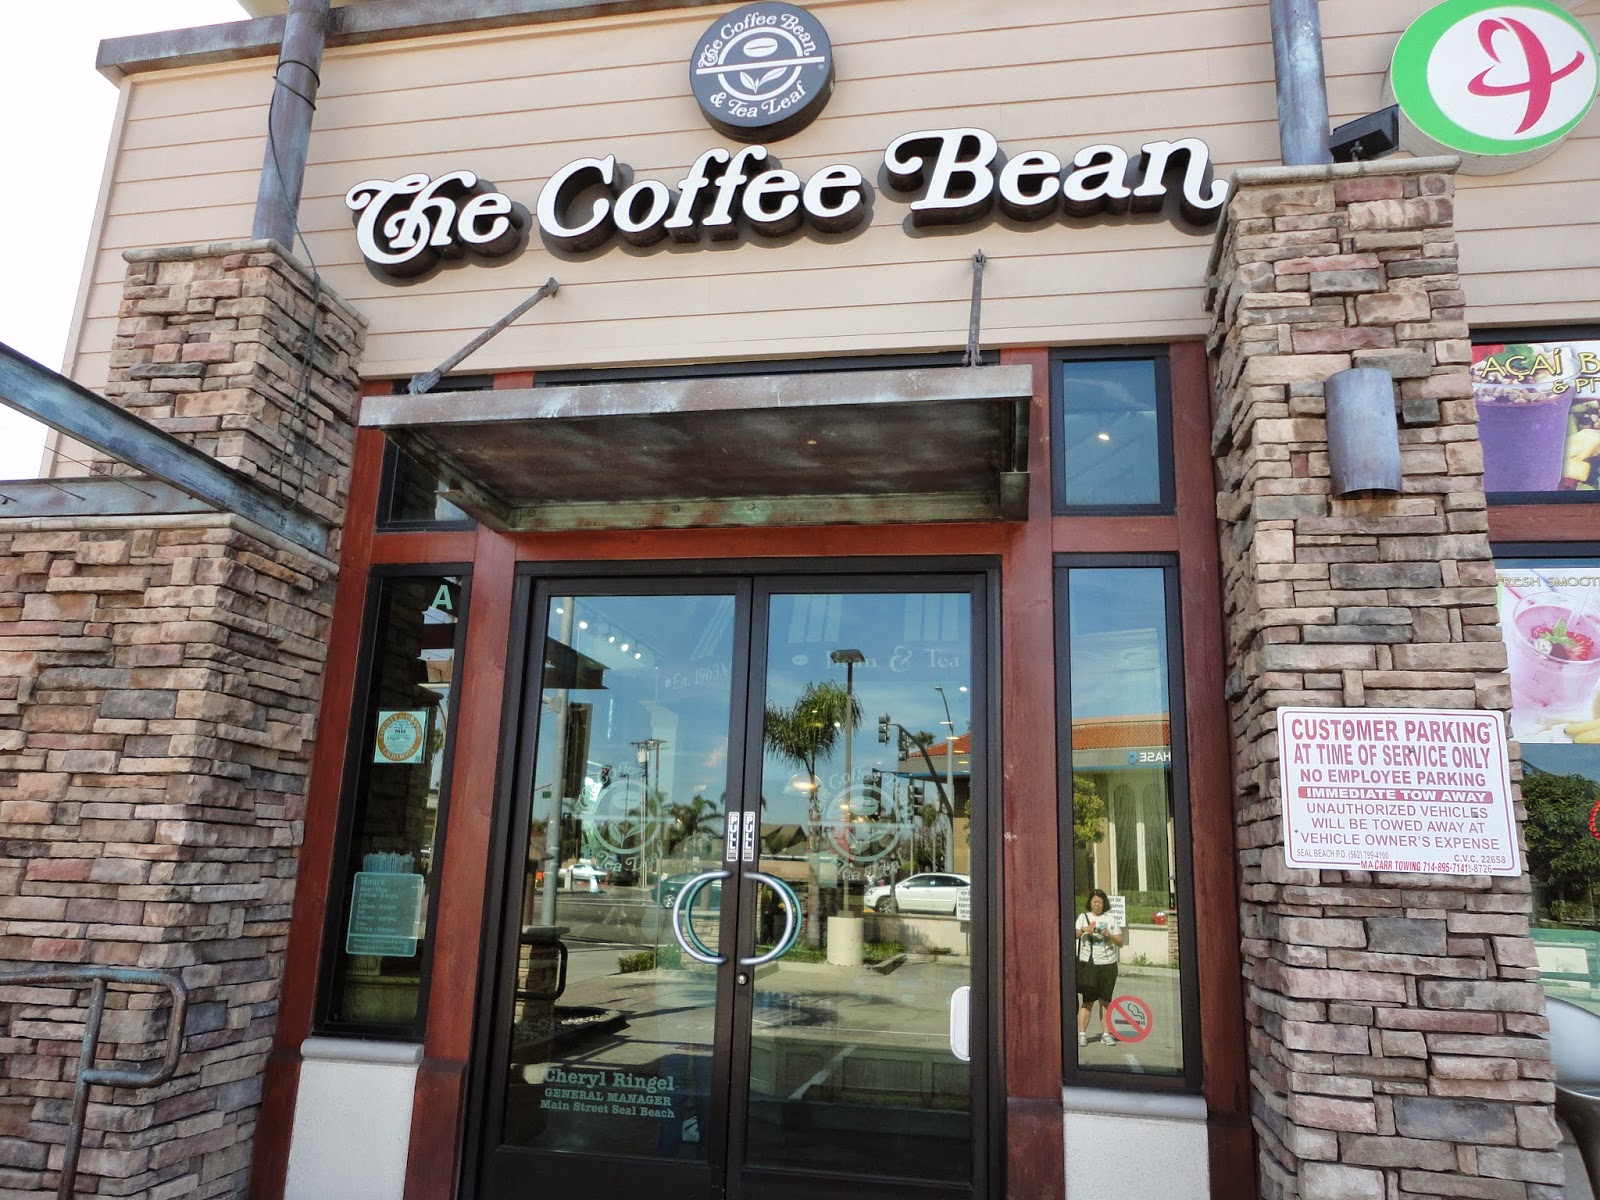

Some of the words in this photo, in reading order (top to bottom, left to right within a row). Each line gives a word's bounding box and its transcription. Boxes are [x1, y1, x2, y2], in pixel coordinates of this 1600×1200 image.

[698, 40, 722, 68] The
[720, 12, 776, 40] Coffee
[780, 13, 816, 56] Bean
[710, 92, 726, 108] &
[728, 99, 758, 118] Tea
[761, 80, 806, 115] Leaf
[345, 170, 511, 264] The
[536, 144, 862, 238] Coffee
[884, 128, 1230, 210] Bean
[1552, 380, 1569, 394] &
[431, 584, 453, 610] A
[890, 645, 912, 672] &
[926, 648, 959, 668] Tea
[1292, 719, 1398, 742] CUSTOMER
[1405, 721, 1490, 744] PARKING
[1294, 744, 1312, 764] AT
[1316, 744, 1353, 765] TIME
[1358, 744, 1377, 765] OF
[1383, 745, 1447, 767] SERVICE
[1452, 746, 1490, 768] ONLY
[1301, 768, 1322, 782] NO
[1328, 769, 1411, 784] EMPLOYEE
[1418, 771, 1486, 786] PARKING
[1306, 788, 1396, 800] IMMEDIATE
[1400, 790, 1436, 800] TOW
[1441, 791, 1487, 802] AWAY
[1307, 803, 1416, 816] UNAUTHORIZED
[1420, 805, 1488, 818] VEHICLES
[1312, 818, 1344, 829] WILL
[1350, 819, 1368, 830] BE
[1372, 820, 1422, 832] TOWED
[1427, 821, 1466, 833] AWAY
[1469, 822, 1485, 833] AT
[1301, 833, 1360, 845] VEHICLE
[1365, 835, 1430, 848] OWNER'S
[1436, 837, 1499, 849] EXPENSE
[598, 850, 622, 872] Tea
[1297, 849, 1312, 857] SEAL
[1314, 849, 1334, 858] BEACH
[1336, 850, 1347, 858] P.D.
[1348, 850, 1362, 860] (562)
[1454, 854, 1478, 863] C.V.C.
[1395, 861, 1420, 871] TOWING
[1423, 862, 1468, 873] 714-895-7141
[545, 1068, 606, 1088] Cheryl
[613, 1072, 675, 1093] Ringel
[545, 1088, 603, 1101] GENERAL
[607, 1092, 672, 1106] MANAGER
[540, 1100, 569, 1111] Main
[573, 1102, 609, 1114] Street
[612, 1105, 636, 1116] Seal
[640, 1107, 675, 1118] Beach
